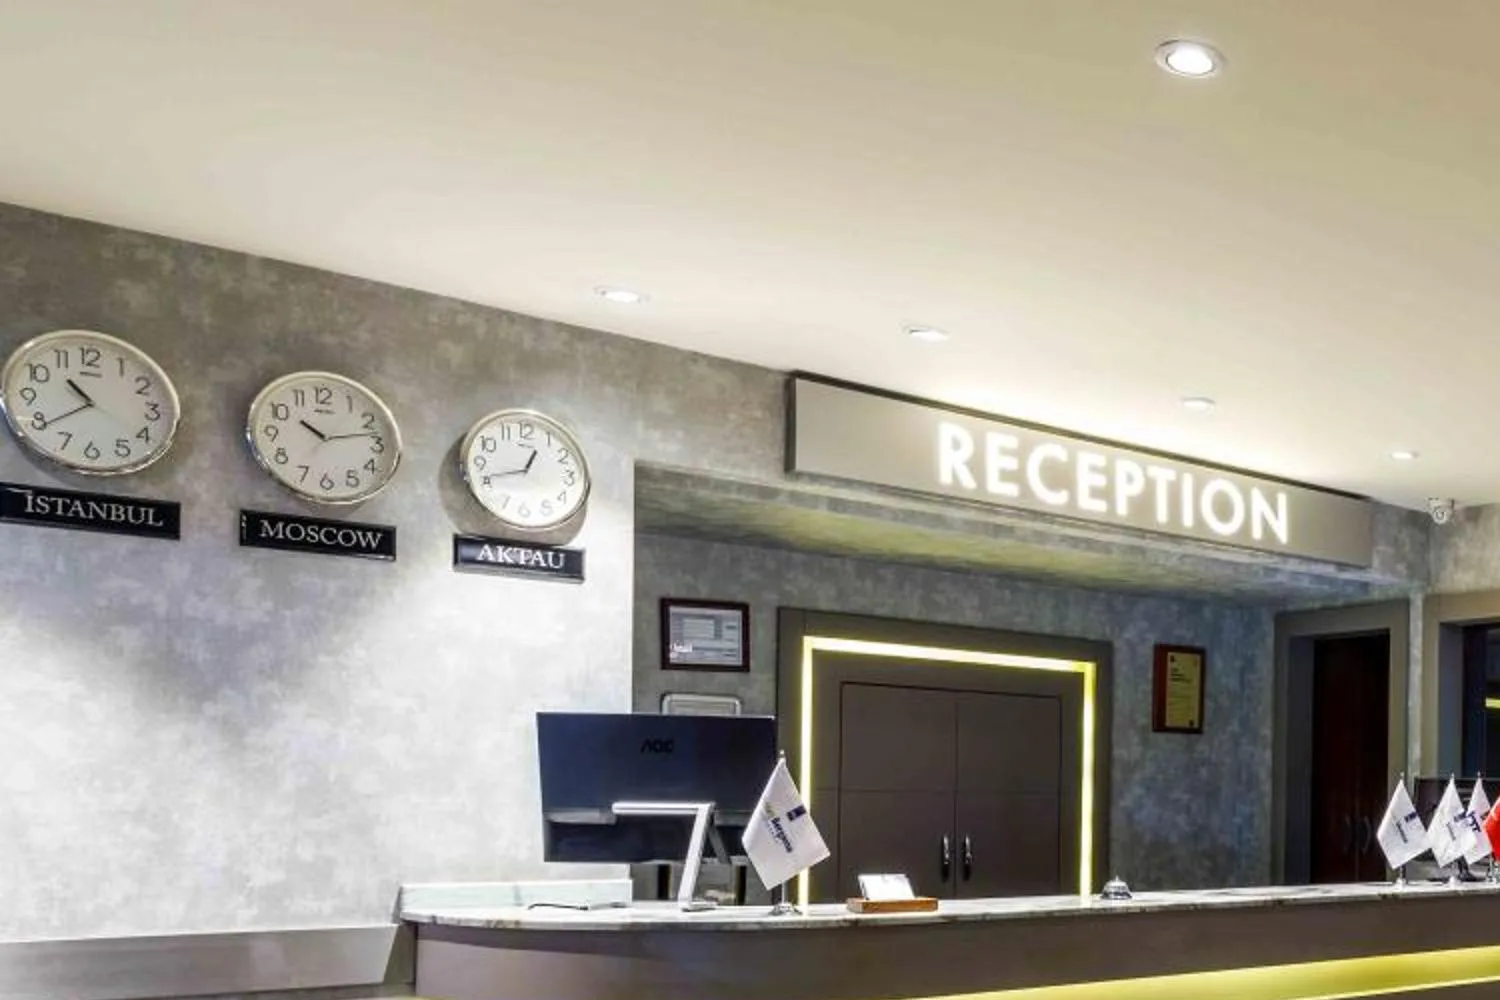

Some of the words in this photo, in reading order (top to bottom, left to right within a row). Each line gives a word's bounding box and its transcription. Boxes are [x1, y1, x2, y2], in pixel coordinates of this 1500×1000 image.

[54, 349, 69, 368] 11
[80, 347, 100, 368] 12
[25, 363, 49, 383] 10
[116, 357, 124, 378] 1
[134, 376, 150, 395] 2
[19, 387, 37, 406] 9
[293, 389, 305, 407] 11
[314, 387, 333, 405] 12
[346, 395, 353, 413] 1
[144, 402, 161, 421] 3
[270, 403, 289, 421] 10
[31, 411, 48, 431] 8
[361, 412, 375, 430] 2
[135, 426, 151, 443] 4
[263, 425, 279, 442] 9
[500, 422, 511, 441] 11
[519, 422, 536, 440] 12
[546, 431, 551, 447] 1
[57, 431, 73, 450] 7
[114, 439, 131, 457] 5
[369, 435, 385, 453] 3
[480, 435, 496, 453] 10
[83, 441, 100, 460] 6
[274, 448, 288, 465] 8
[557, 447, 569, 464] 2
[363, 459, 376, 474] 4
[473, 455, 486, 470] 9
[297, 465, 310, 483] 7
[319, 473, 335, 490] 6
[345, 469, 360, 488] 5
[564, 470, 575, 487] 3
[938, 421, 1289, 544] RECEPTION
[518, 501, 531, 518] 6
[540, 499, 553, 517] 5
[260, 519, 382, 549] MOSCOW
[476, 543, 565, 569] AKTAU
